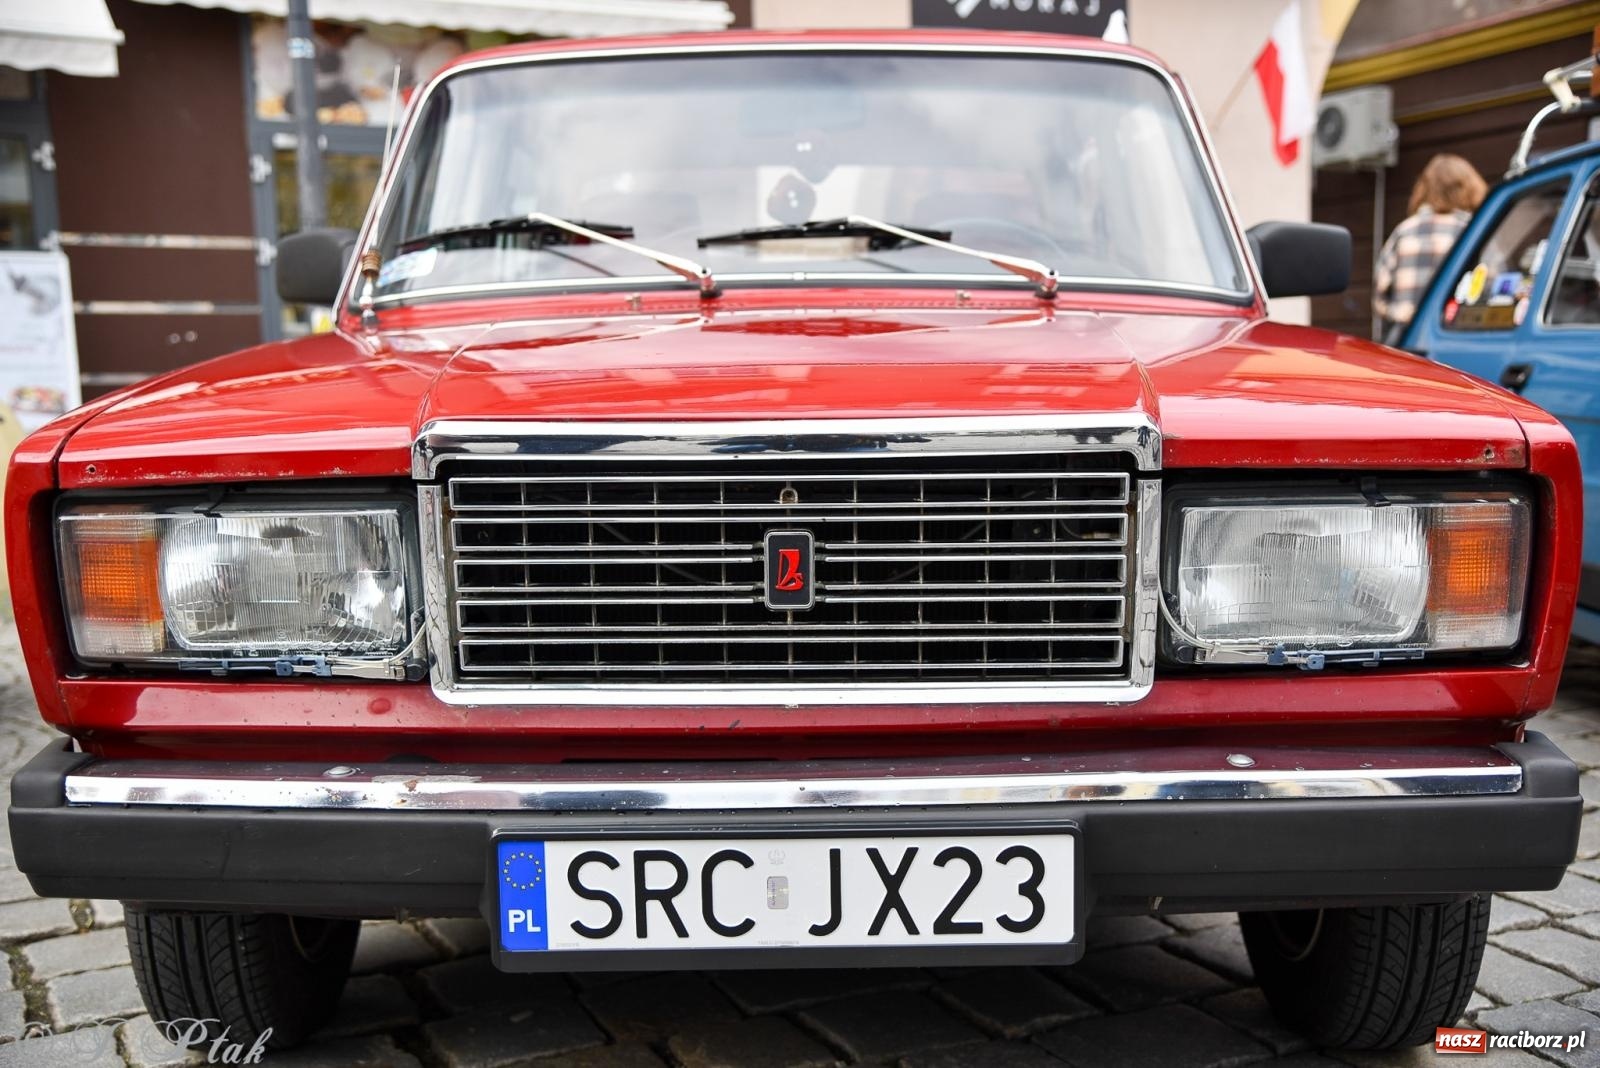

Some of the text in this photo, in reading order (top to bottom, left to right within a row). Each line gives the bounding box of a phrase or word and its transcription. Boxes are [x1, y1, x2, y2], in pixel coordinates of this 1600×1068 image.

[508, 909, 541, 933] PL
[567, 846, 1046, 939] SRC JX23
